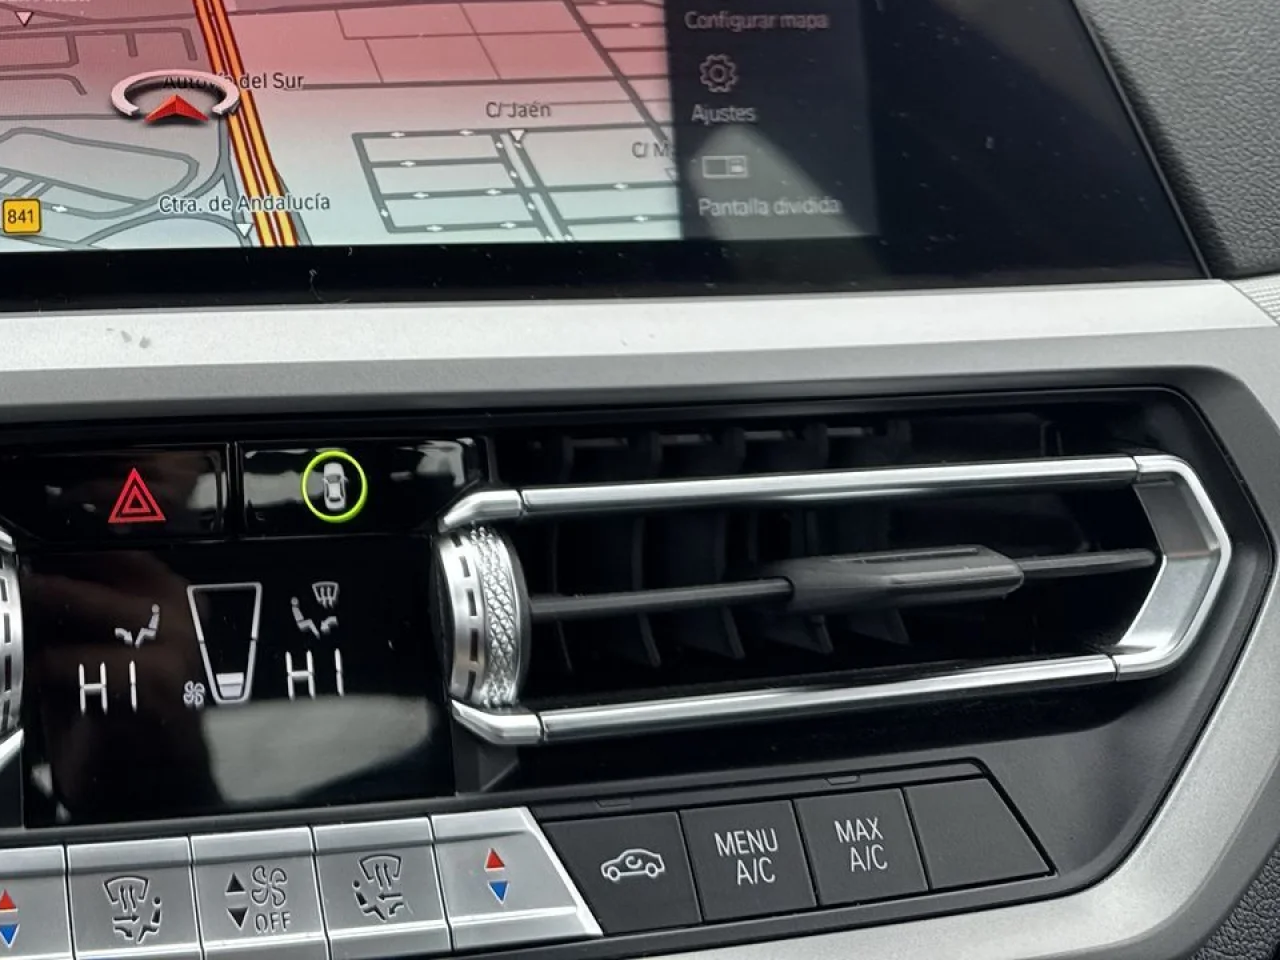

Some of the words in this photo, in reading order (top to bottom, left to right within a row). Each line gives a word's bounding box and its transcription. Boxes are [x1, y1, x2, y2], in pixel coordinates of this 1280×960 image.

[685, 10, 775, 33] Configurar
[779, 15, 830, 32] mapa
[239, 72, 268, 89] del
[272, 72, 304, 89] Sur
[486, 102, 506, 118] C/
[508, 101, 551, 118] Jaén
[692, 104, 756, 124] Ajustes
[159, 196, 202, 212] Ctra.
[209, 196, 231, 211] de
[237, 193, 330, 211] Andalucía
[699, 197, 769, 216] Pantalla
[773, 197, 841, 215] dividida
[7, 210, 35, 224] 841
[834, 817, 884, 844] MAX
[714, 827, 778, 858] MENU
[849, 843, 888, 872] A/C
[736, 857, 776, 886] A/C
[255, 911, 291, 932] OFF
